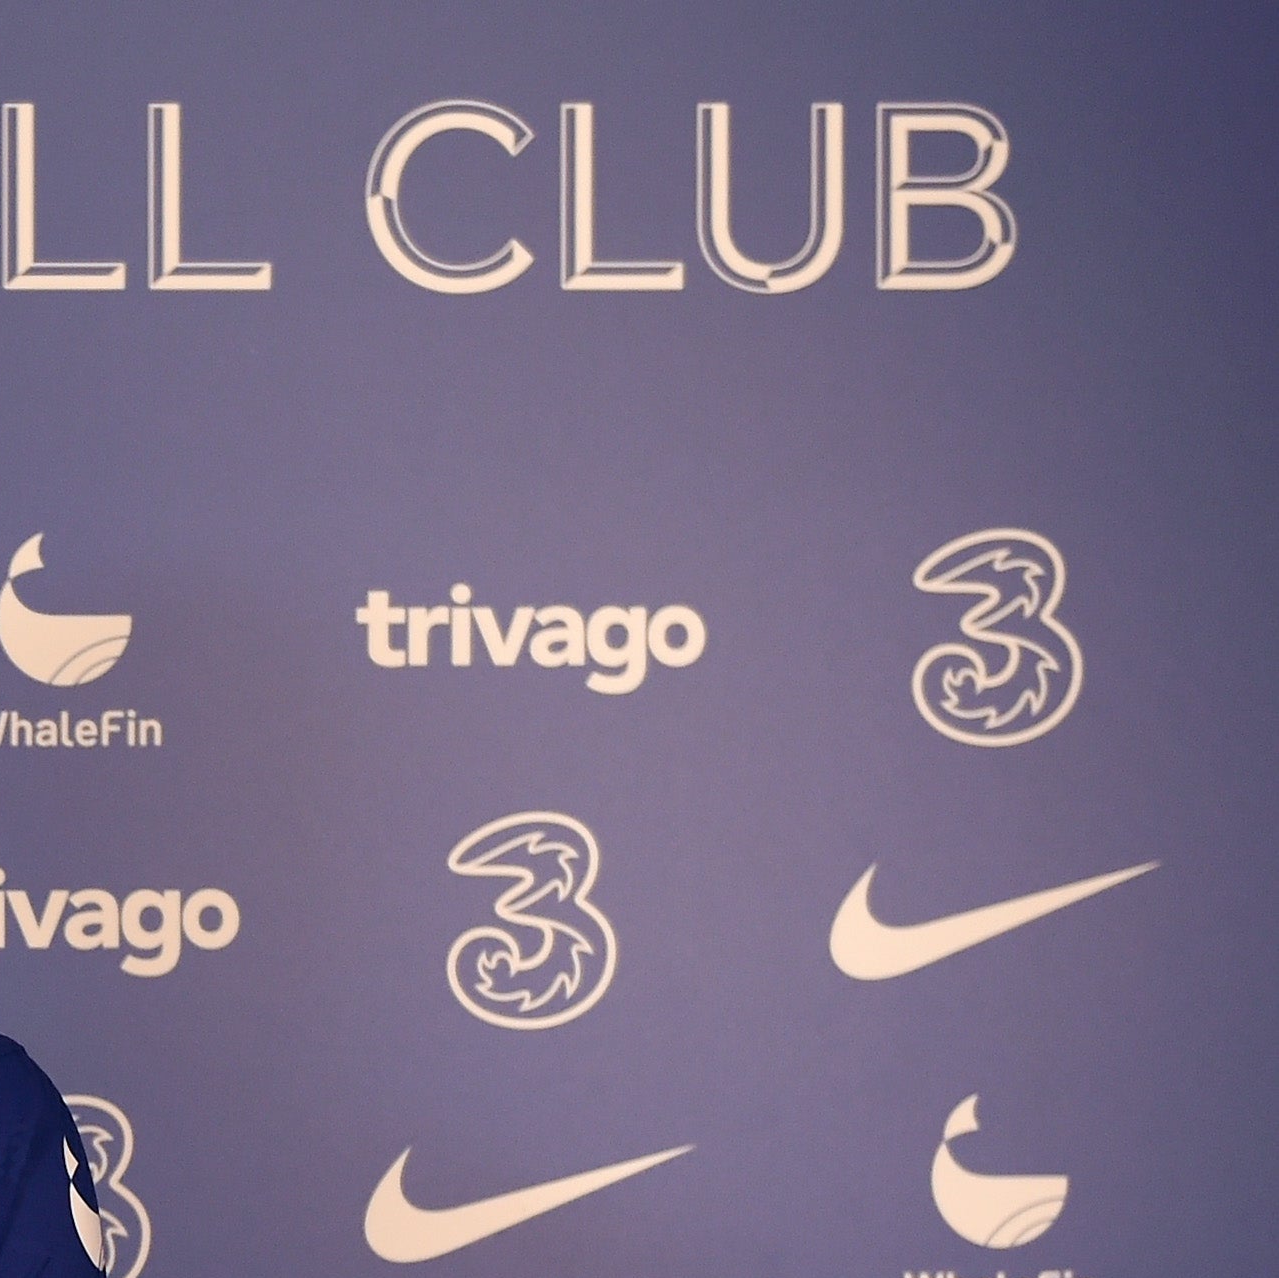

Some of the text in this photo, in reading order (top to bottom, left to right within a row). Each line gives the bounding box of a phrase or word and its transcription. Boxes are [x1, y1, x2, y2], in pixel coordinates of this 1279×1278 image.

[366, 100, 1017, 294] CLUB
[356, 583, 706, 694] trivago
[912, 528, 1083, 747] 3
[447, 812, 617, 1029] 3
